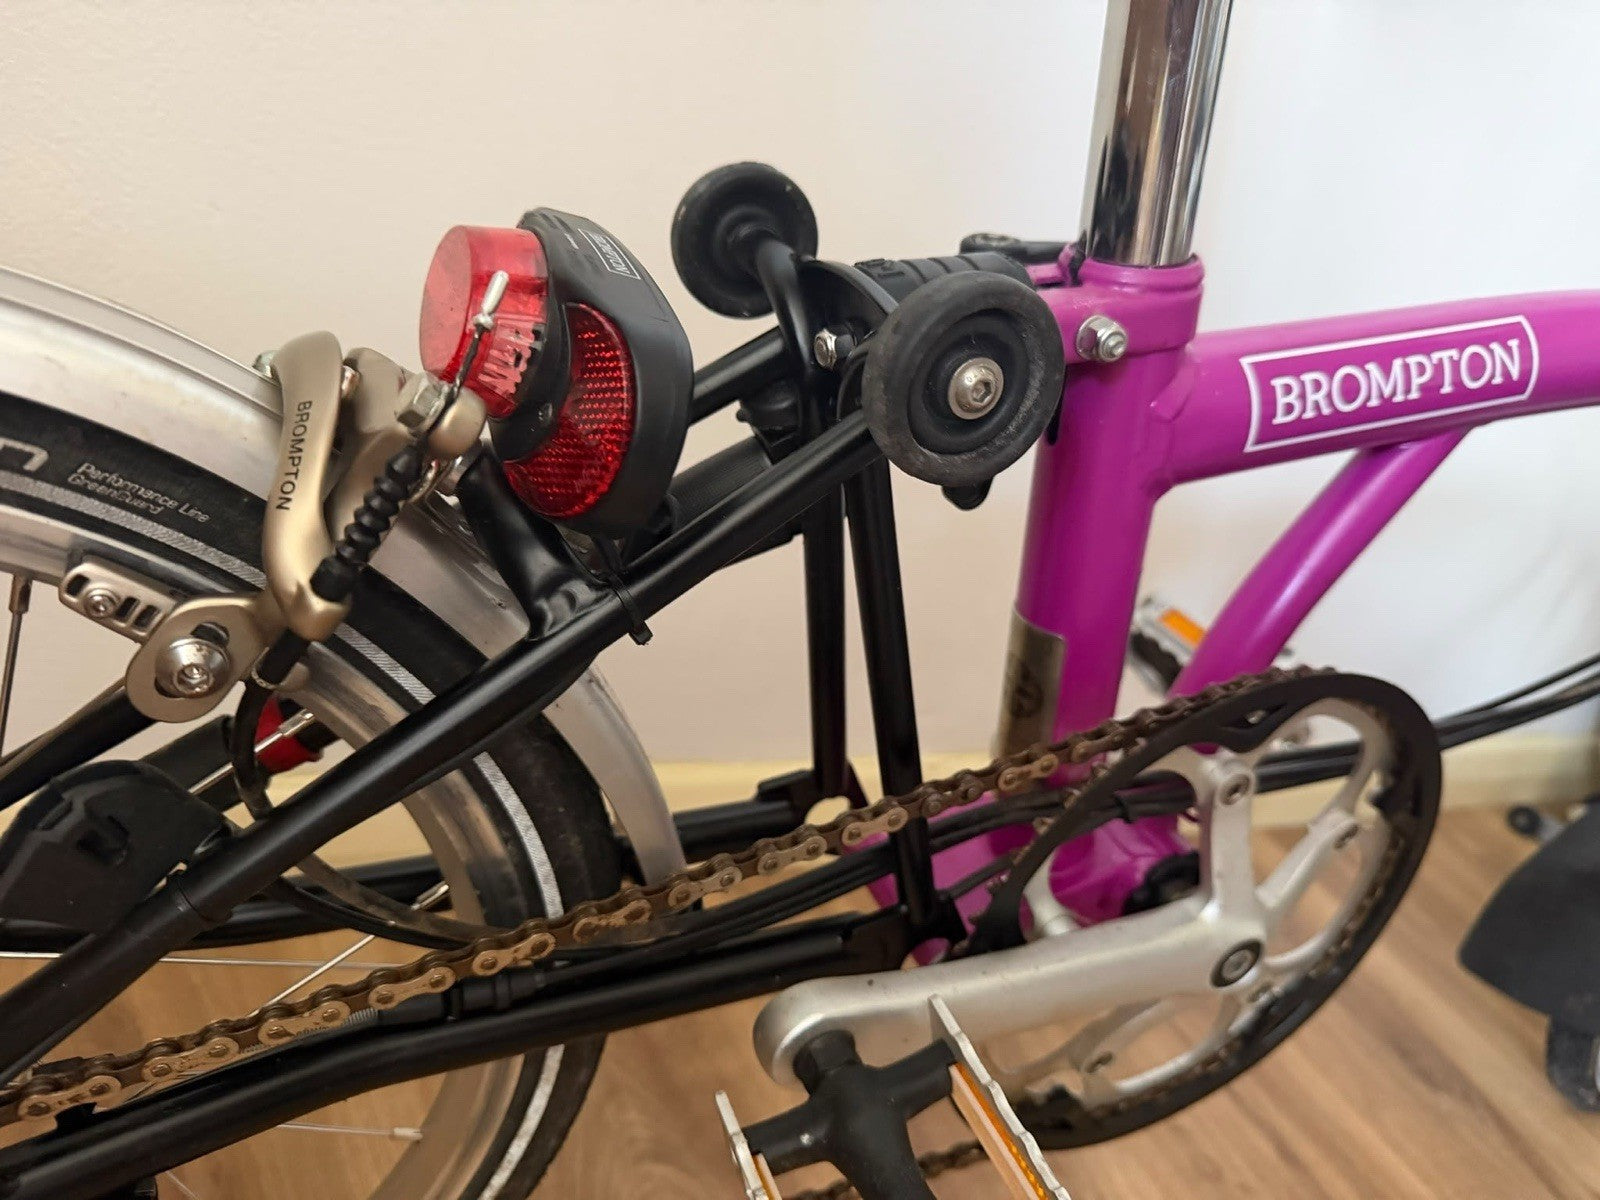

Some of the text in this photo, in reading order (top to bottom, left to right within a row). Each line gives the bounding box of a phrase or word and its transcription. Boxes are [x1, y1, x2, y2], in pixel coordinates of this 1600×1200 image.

[1270, 337, 1521, 426] BROMPTON
[76, 462, 211, 523] Performance Line
[275, 400, 313, 511] BROMPTON
